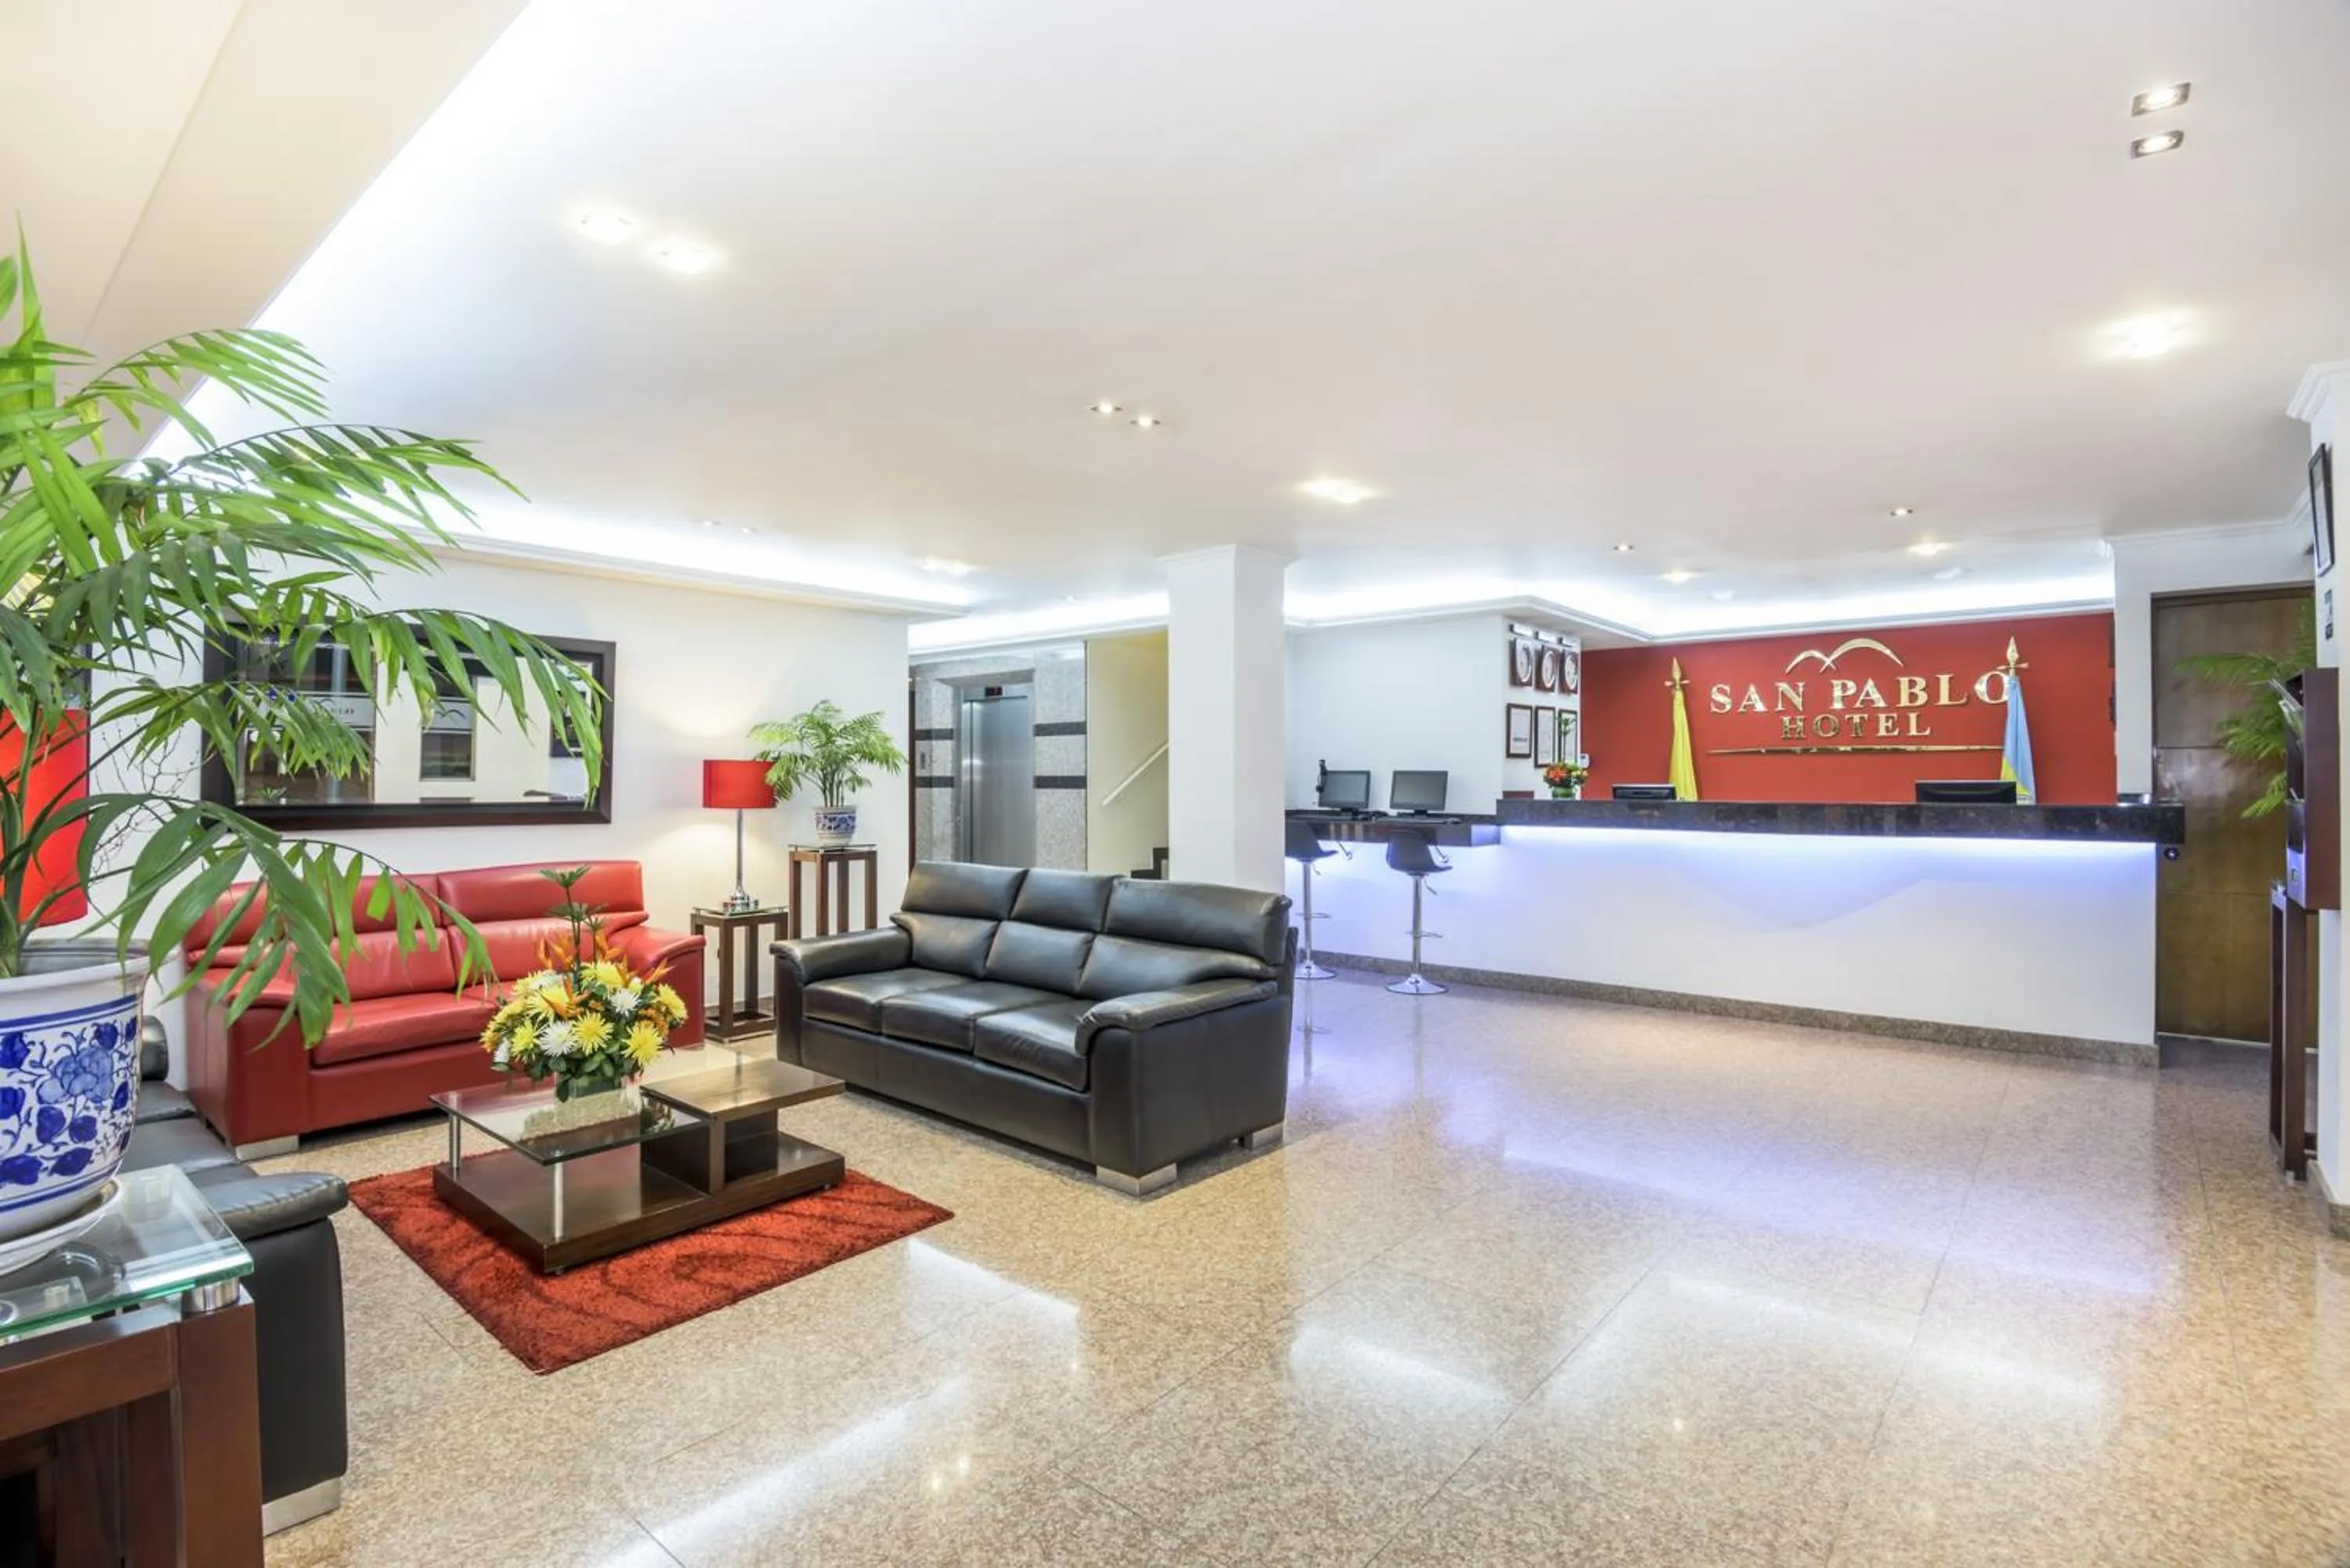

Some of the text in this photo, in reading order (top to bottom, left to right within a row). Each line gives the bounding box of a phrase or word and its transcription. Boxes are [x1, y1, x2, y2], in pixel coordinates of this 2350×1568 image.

[1710, 670, 2011, 714] SAN PABLO
[1781, 712, 1931, 739] HOTEL
